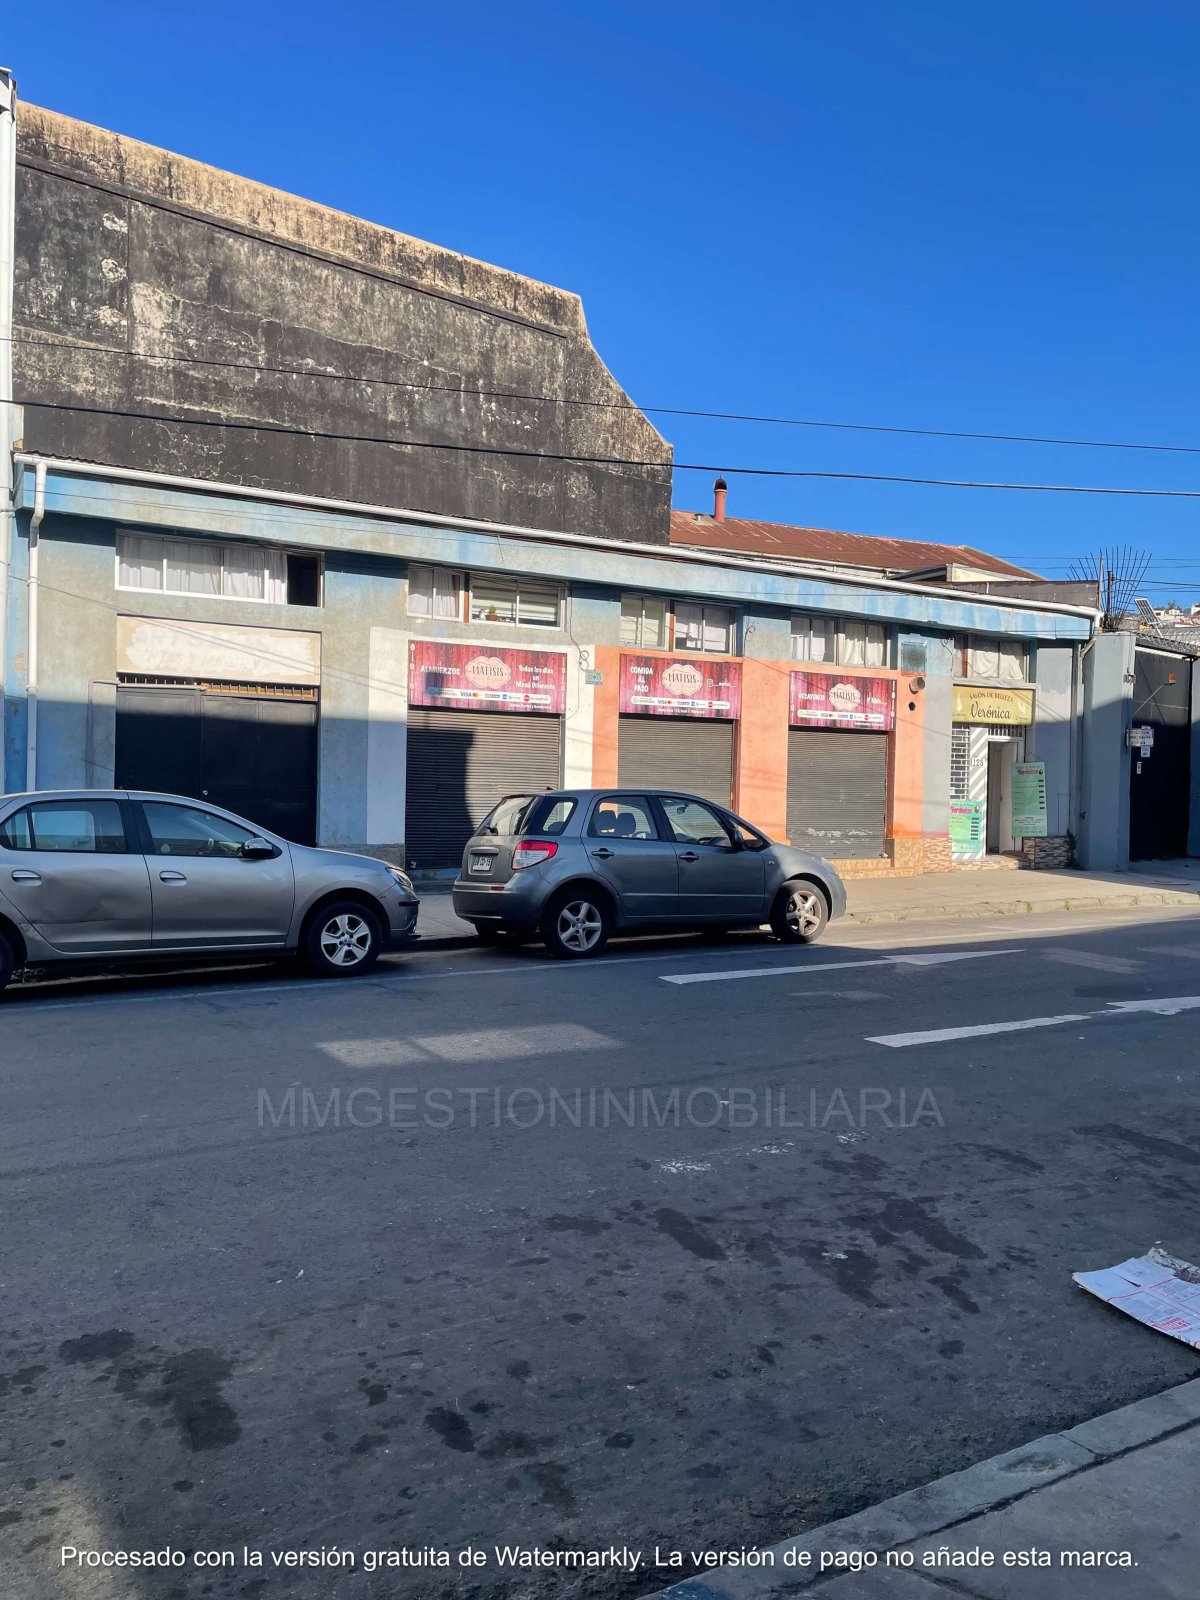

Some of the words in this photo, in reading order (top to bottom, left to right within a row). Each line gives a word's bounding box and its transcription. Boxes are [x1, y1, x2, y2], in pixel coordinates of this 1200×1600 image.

[420, 665, 460, 675] ALMUERZOS
[518, 664, 533, 673] Todos
[630, 666, 653, 676] COMIDA
[637, 675, 646, 683] AL
[633, 684, 649, 693] PASO
[969, 692, 986, 701] SALÓN
[994, 692, 1014, 703] BELLEZA
[971, 700, 1011, 720] Verónica
